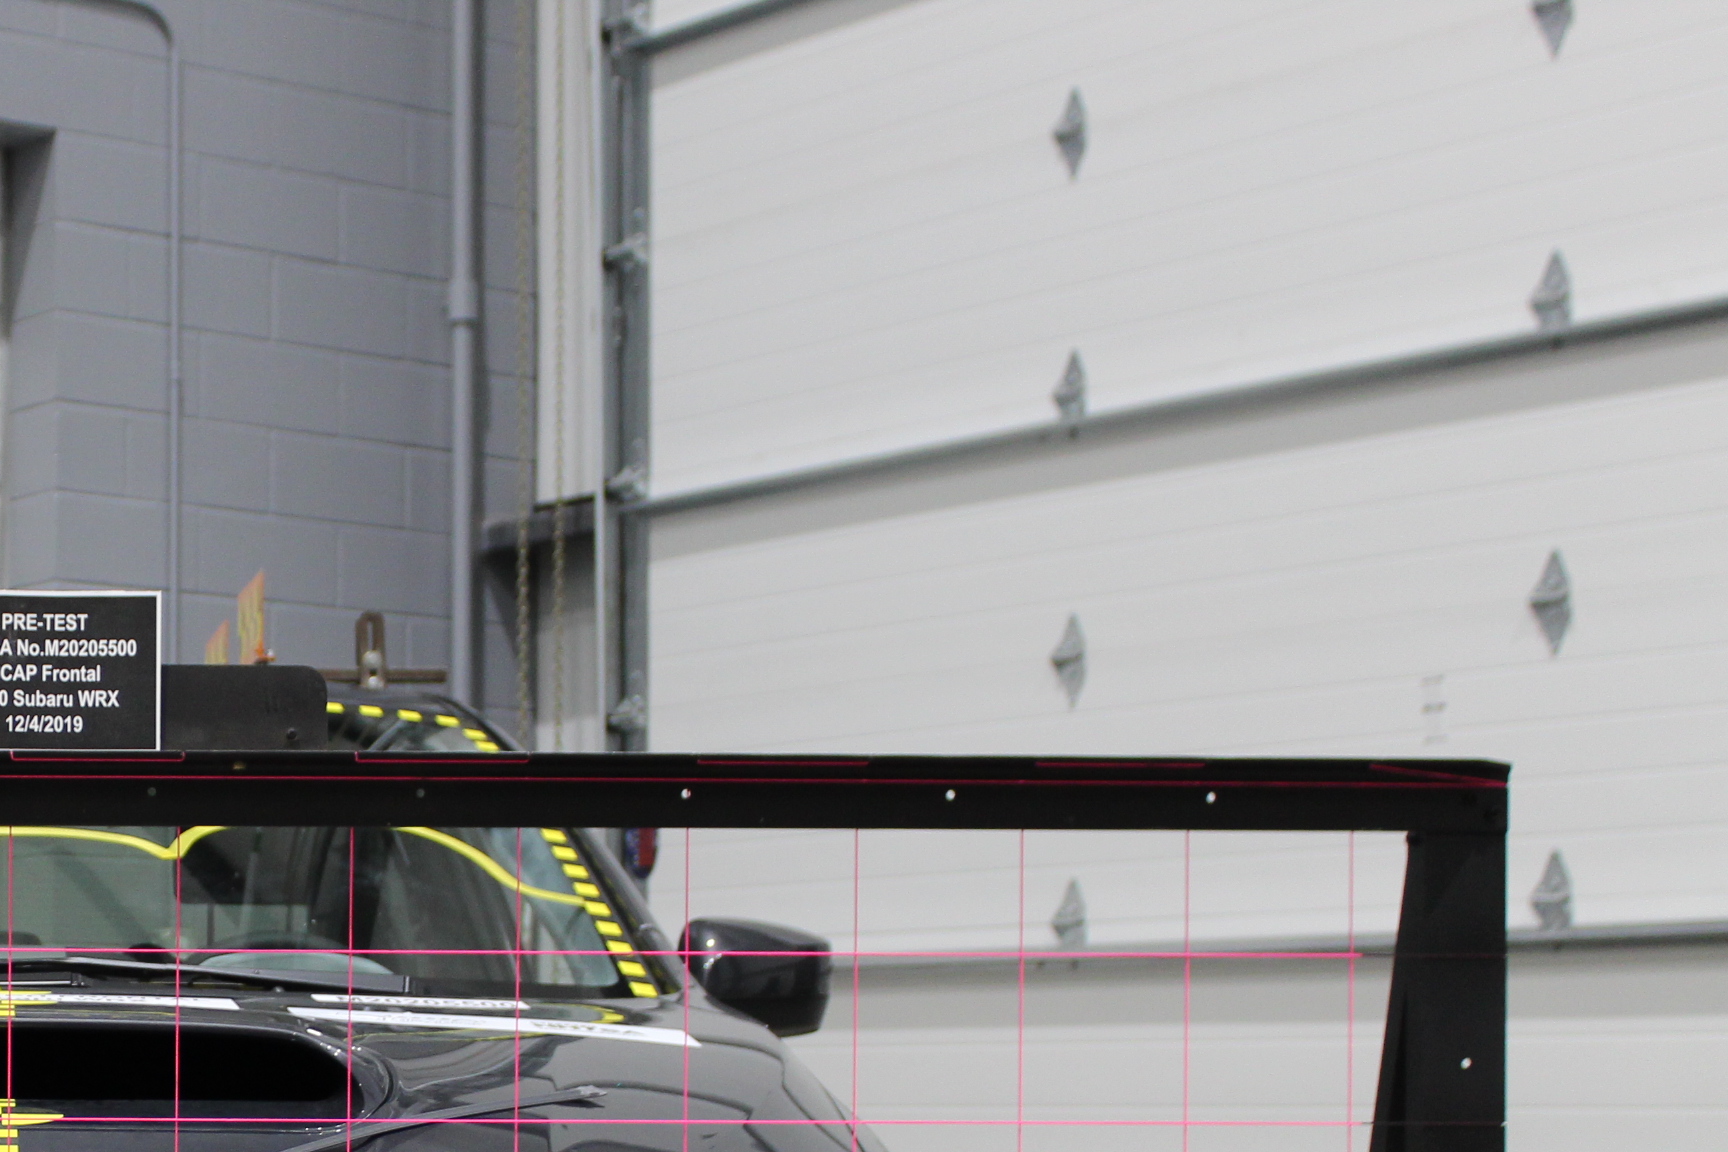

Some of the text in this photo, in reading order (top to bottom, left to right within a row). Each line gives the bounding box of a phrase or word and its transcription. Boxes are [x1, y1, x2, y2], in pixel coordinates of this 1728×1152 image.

[2, 613, 88, 631] PRE-TEST
[42, 665, 101, 682] Frontal
[13, 690, 73, 707] Subaru
[77, 690, 119, 708] WRX
[5, 715, 83, 733] 12/4/2019
